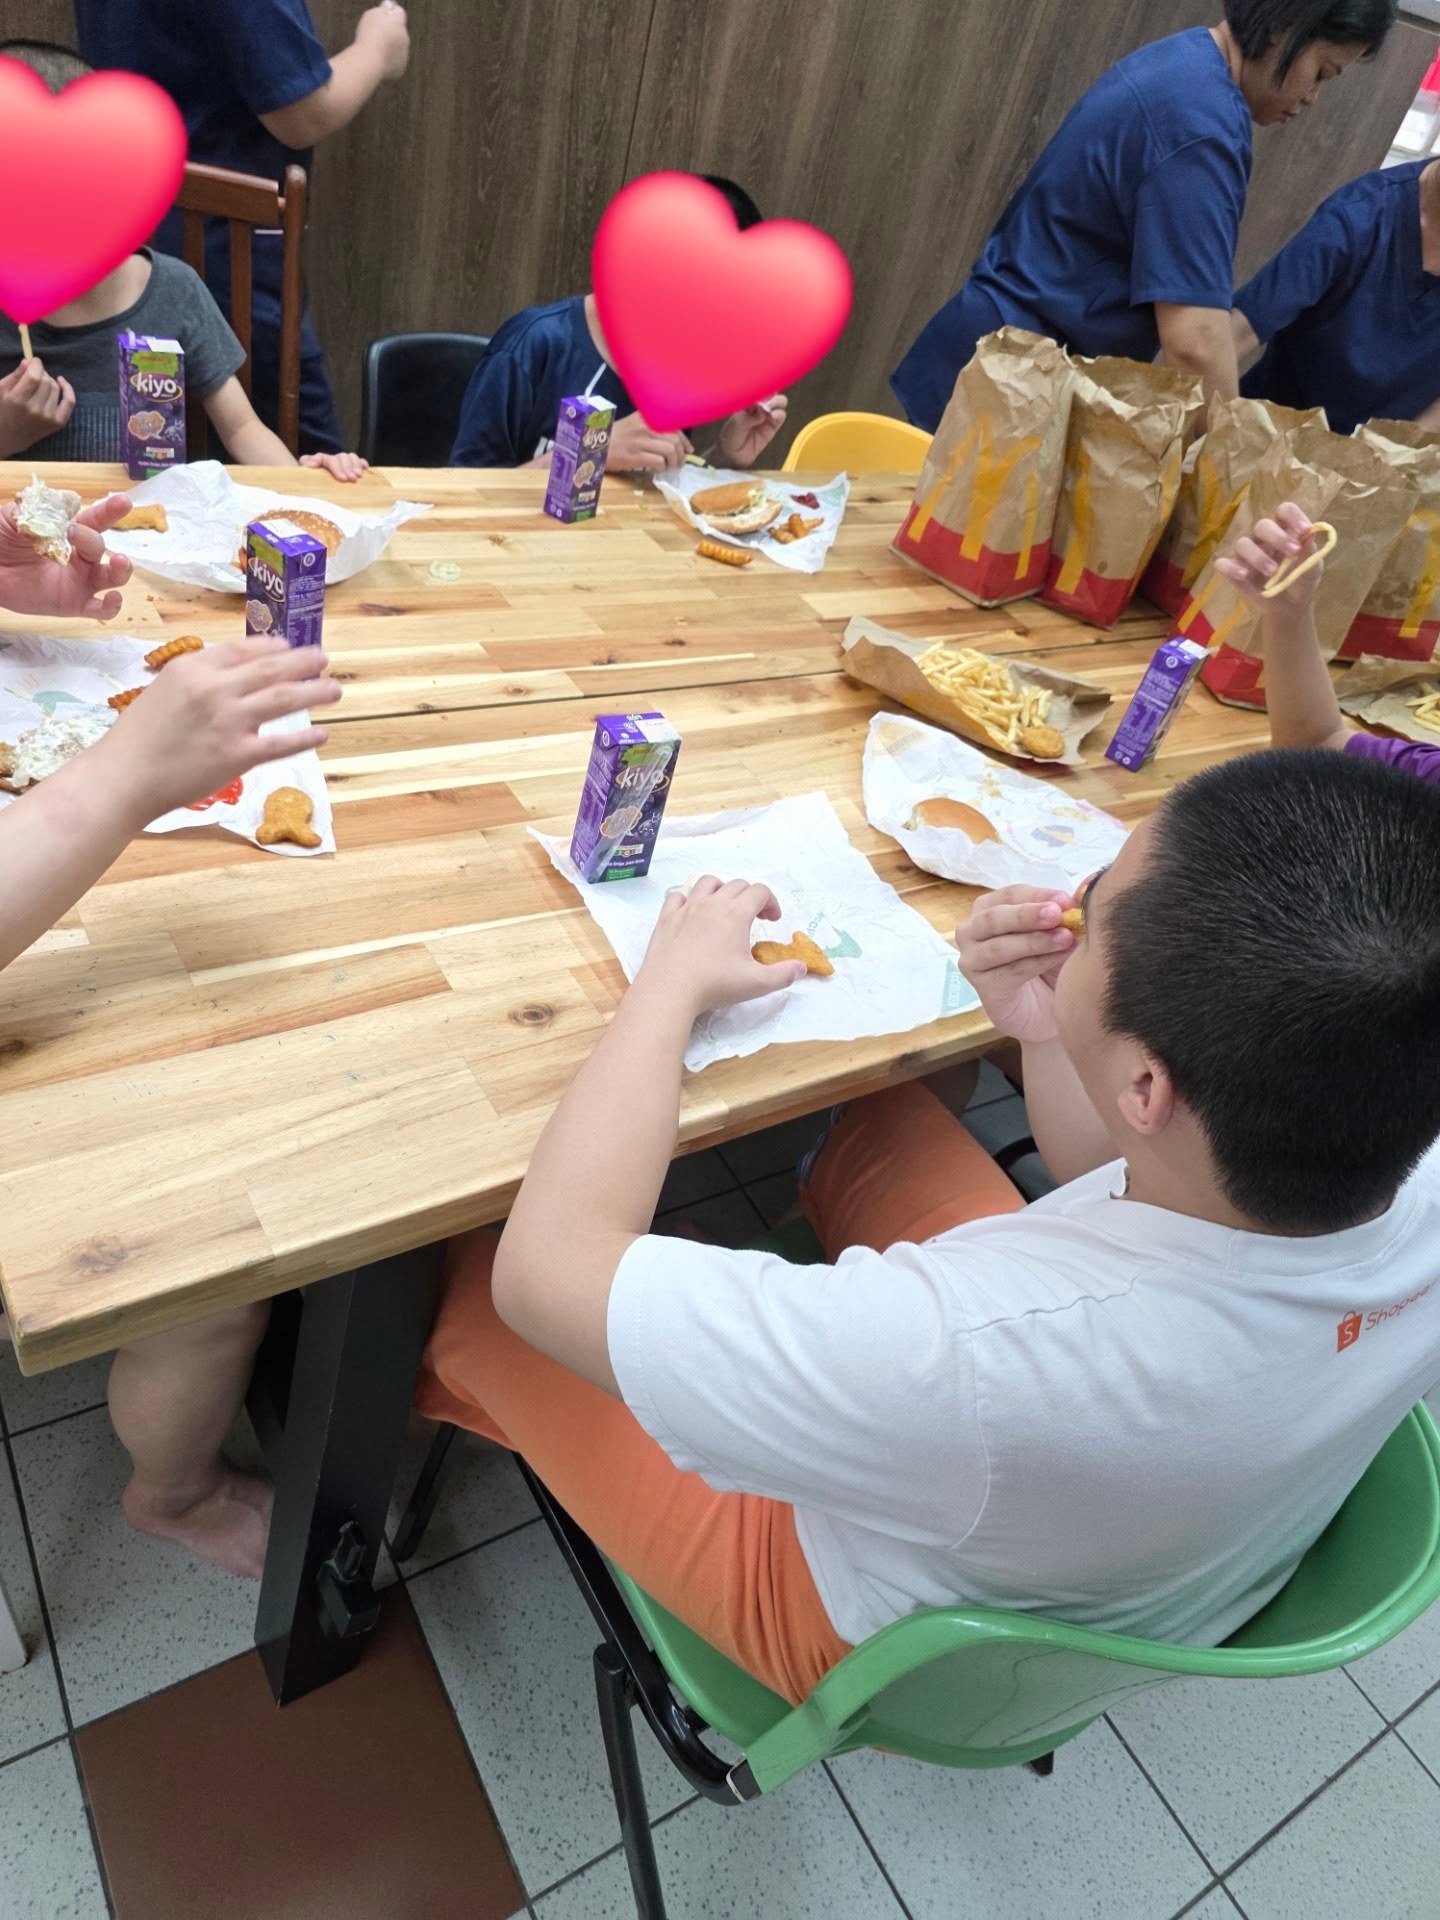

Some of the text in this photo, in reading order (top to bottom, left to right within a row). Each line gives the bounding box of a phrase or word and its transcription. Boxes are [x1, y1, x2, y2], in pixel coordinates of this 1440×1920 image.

[136, 372, 177, 398] kiyo
[252, 557, 284, 593] kiyo
[620, 767, 664, 791] kiyo
